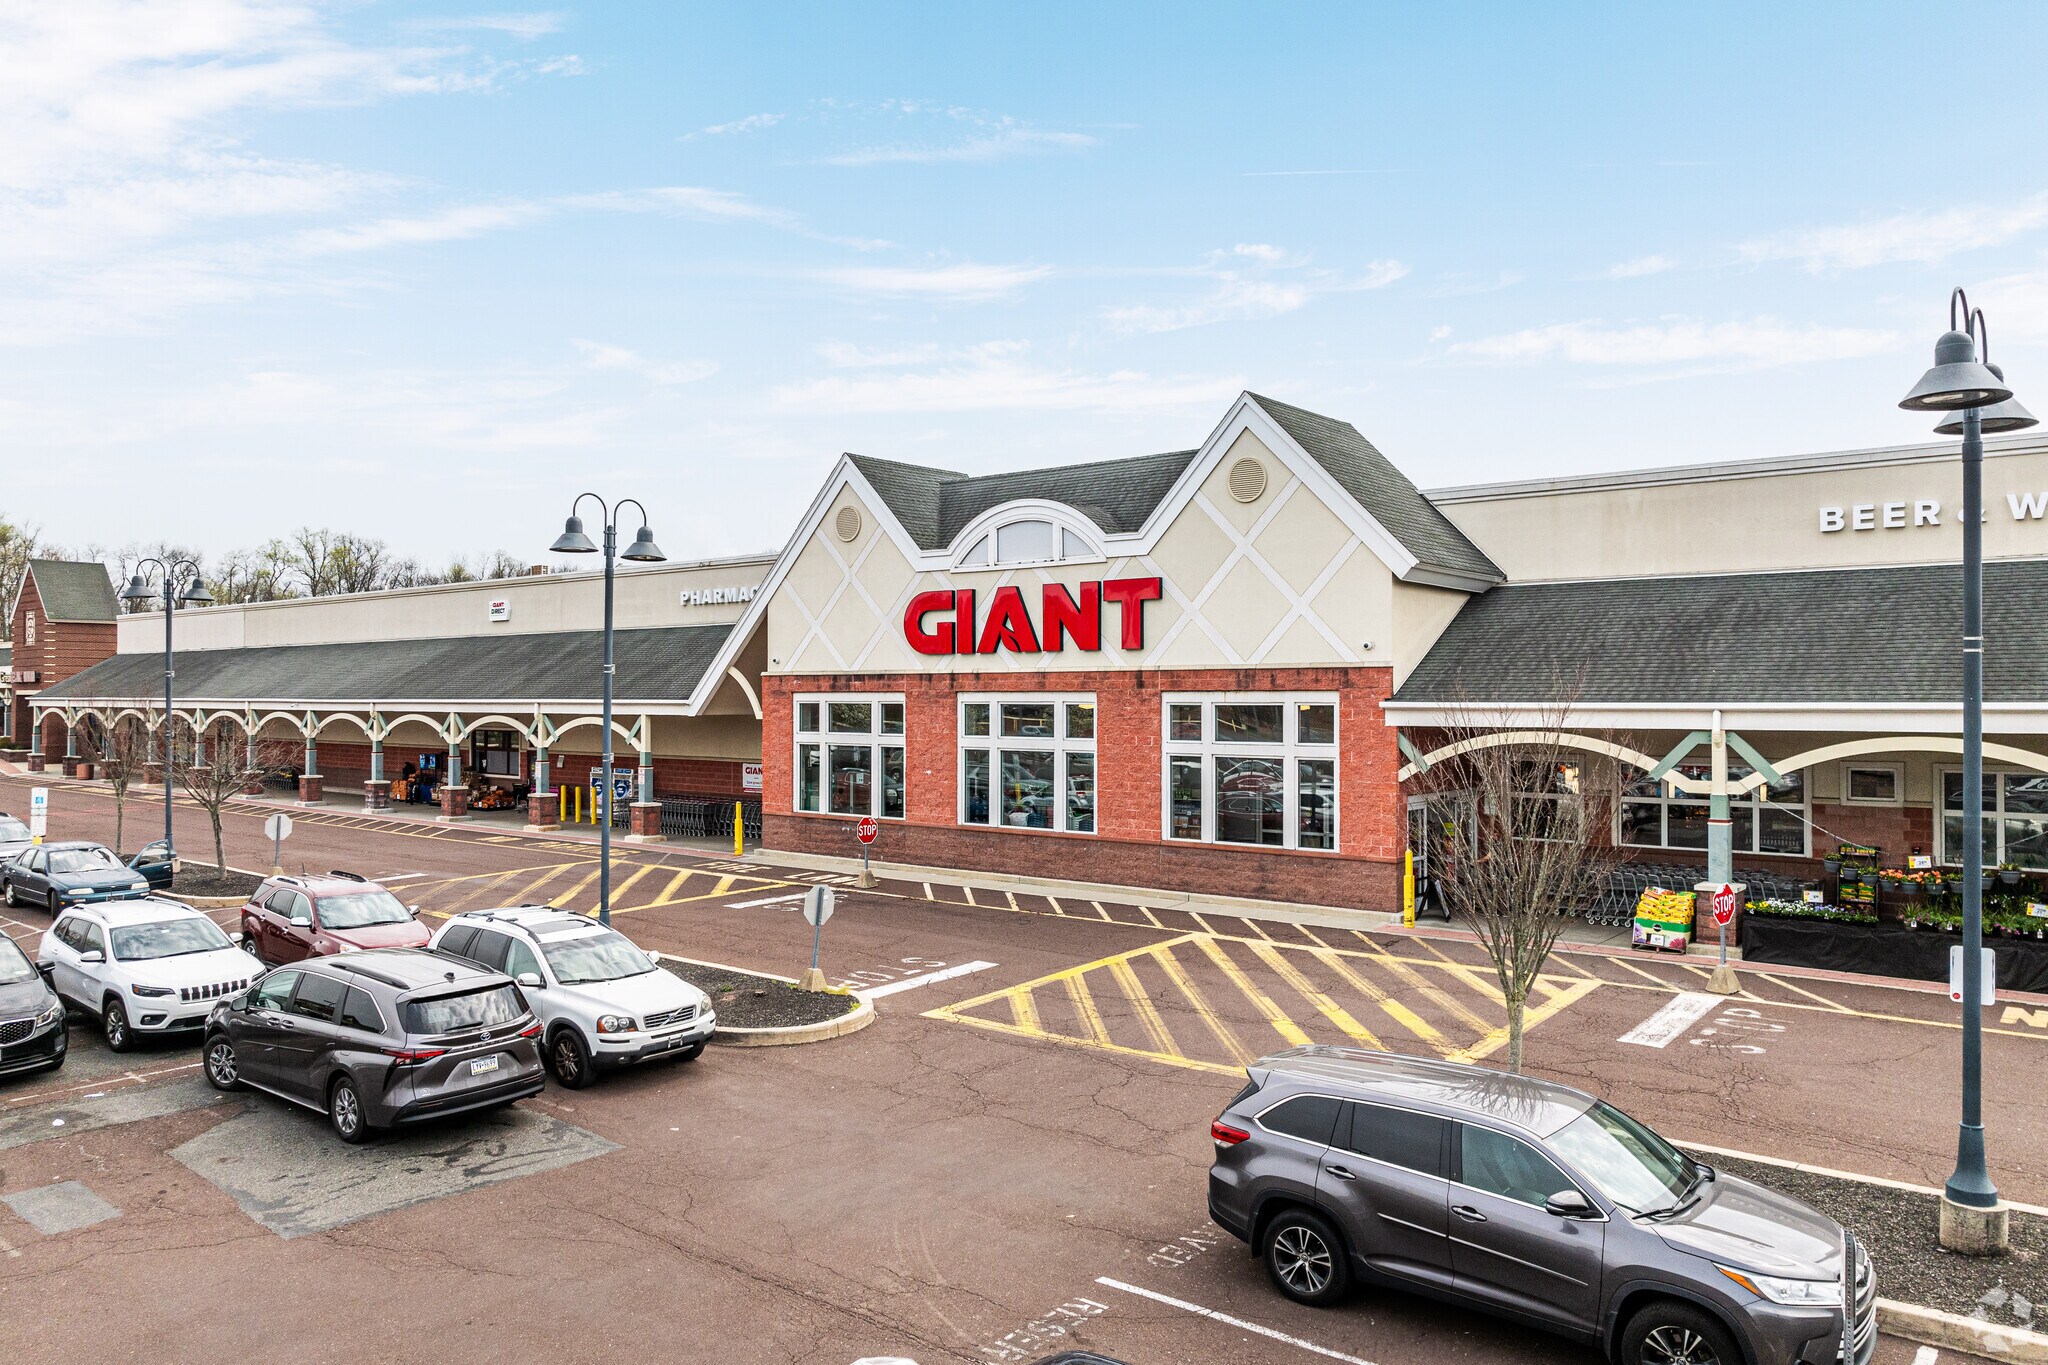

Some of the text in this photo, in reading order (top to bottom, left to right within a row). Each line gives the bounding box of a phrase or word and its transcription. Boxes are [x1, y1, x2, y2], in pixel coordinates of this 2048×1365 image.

[1819, 499, 1941, 533] BEER
[903, 576, 1163, 656] GIANT
[858, 824, 877, 836] STOP
[1714, 894, 1734, 914] STOP
